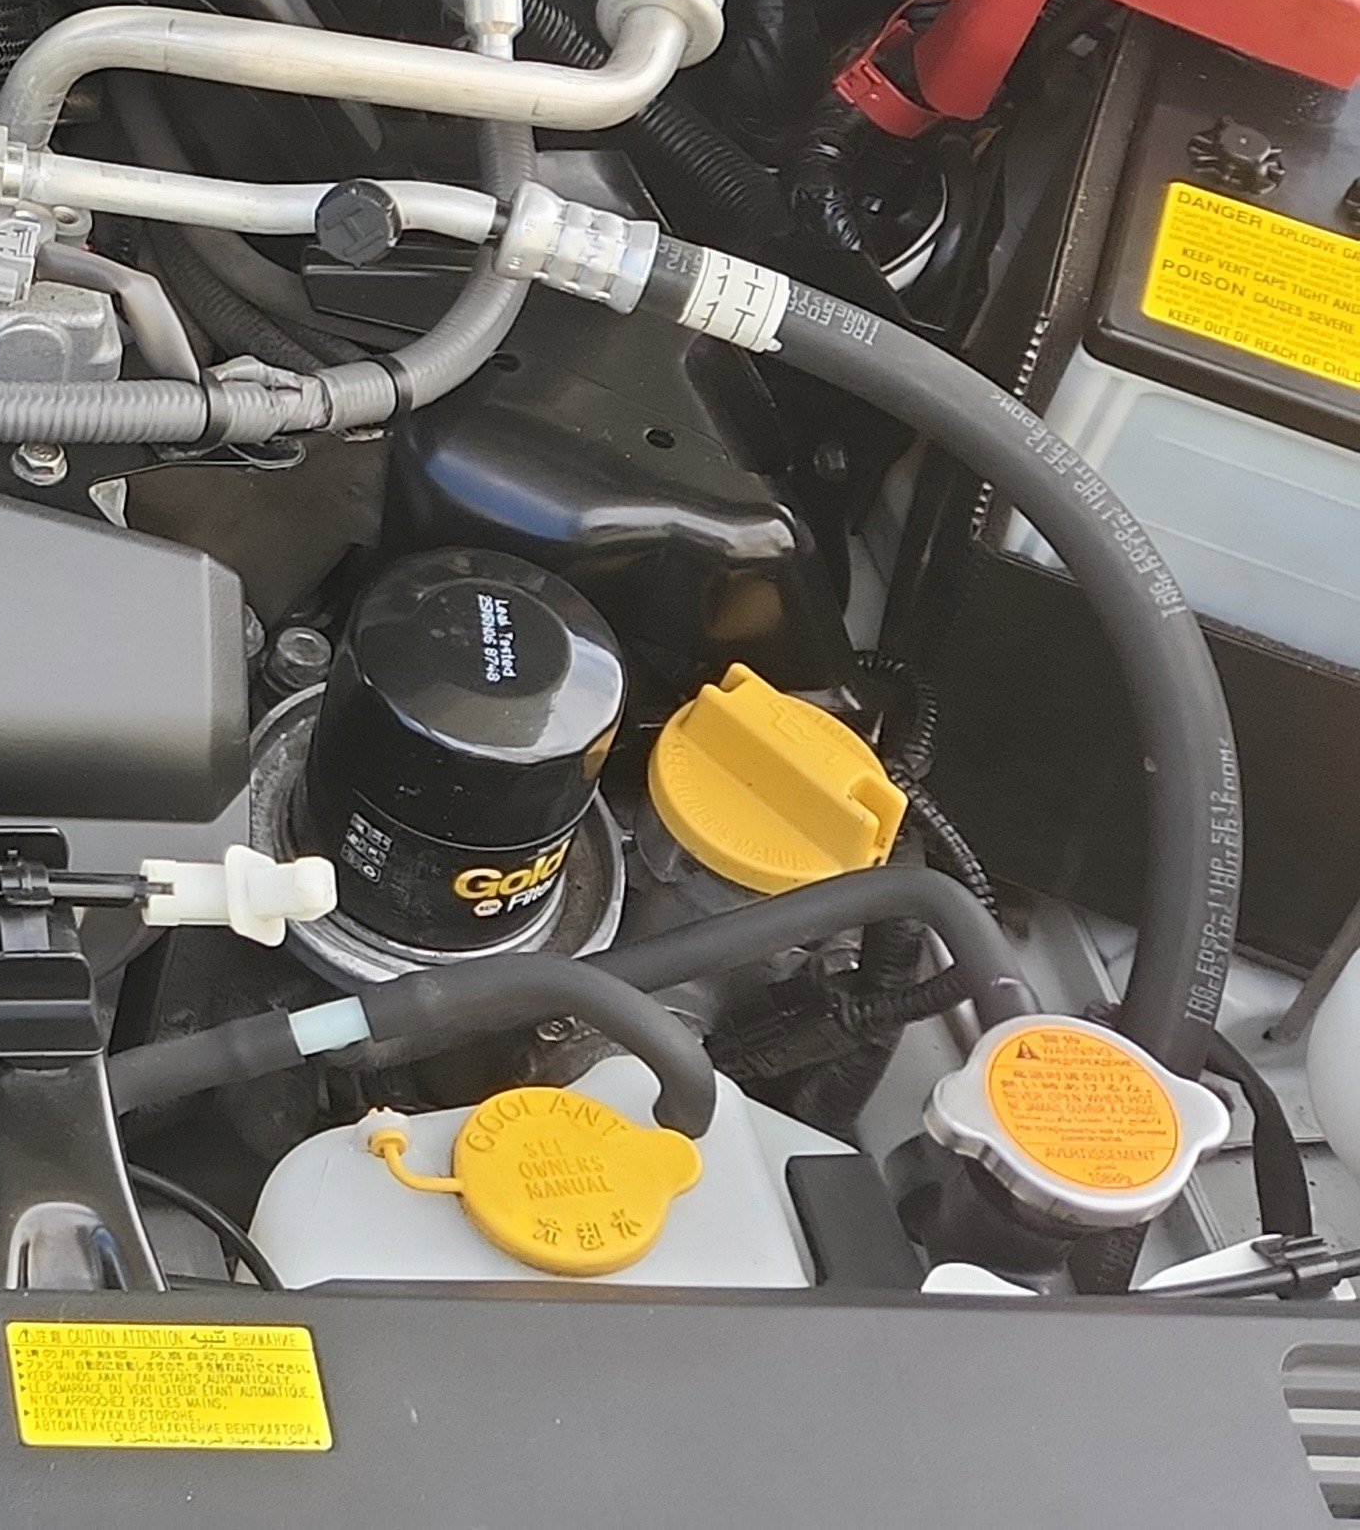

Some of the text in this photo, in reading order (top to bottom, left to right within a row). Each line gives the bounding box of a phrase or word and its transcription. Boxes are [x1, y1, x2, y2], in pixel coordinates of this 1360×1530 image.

[1177, 190, 1263, 228] DANGER
[1270, 223, 1337, 254] EXPLOSIVE
[1182, 247, 1214, 264] KEEP
[1218, 256, 1250, 276] VENT
[1254, 271, 1287, 291] CAPS
[1292, 283, 1329, 305] TIGHT
[1161, 259, 1355, 334] POISON CAUSES SEVERE
[1168, 308, 1201, 327] KEEP
[1204, 320, 1230, 337] OUT
[1234, 330, 1250, 344] OF
[1254, 337, 1299, 361] REACH
[1302, 353, 1319, 367] OF
[454, 838, 572, 899] Gold
[525, 1175, 614, 1200] MANUAL
[67, 1328, 183, 1347] CAUTION ATTENTION
[232, 1331, 297, 1347] ВНИМАНИЕ
[26, 1371, 53, 1382] KEEP
[59, 1372, 92, 1383] HANDS
[159, 1372, 202, 1384] STARTS
[109, 1383, 122, 1395] DU
[127, 1383, 196, 1397] VENTILATEUR
[65, 1395, 126, 1408] APPROCHEZ
[132, 1396, 154, 1408] PAS
[159, 1397, 181, 1409] LES
[186, 1397, 228, 1410] MAINS.
